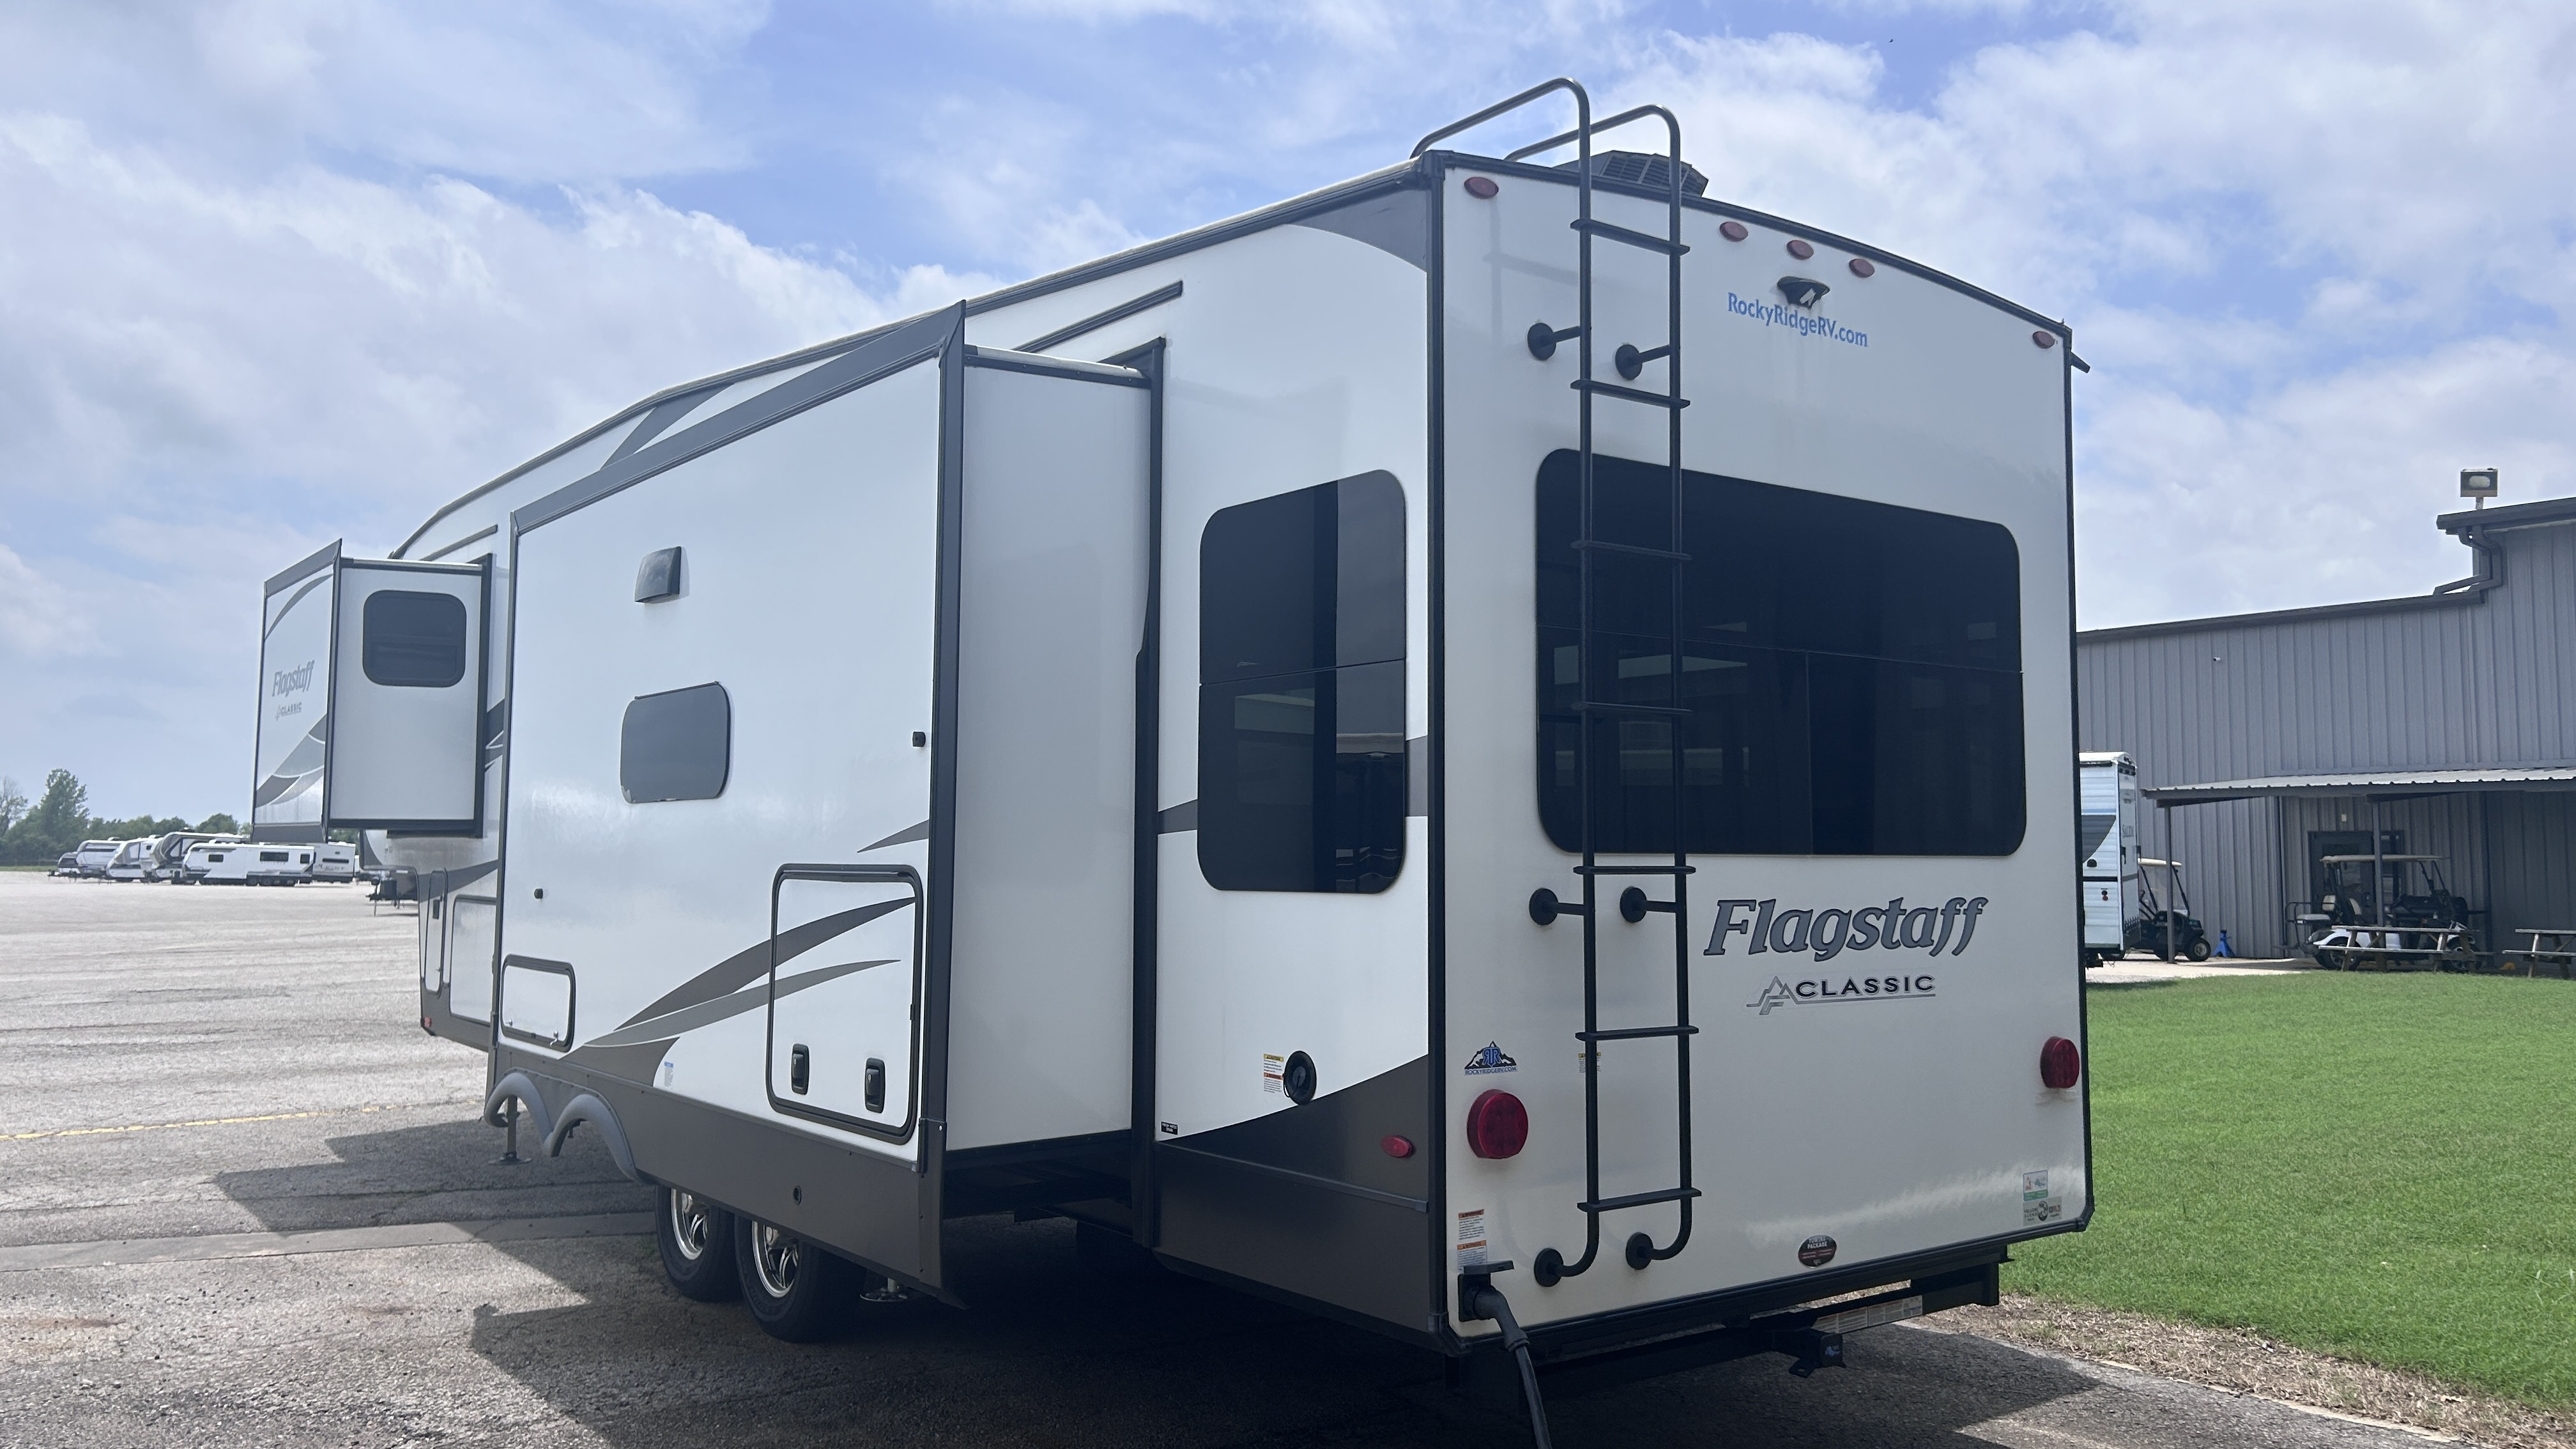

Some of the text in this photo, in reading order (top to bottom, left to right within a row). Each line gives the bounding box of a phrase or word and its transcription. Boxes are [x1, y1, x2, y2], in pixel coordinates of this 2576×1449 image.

[1727, 291, 1869, 348] RockyRidgeRV.com
[272, 659, 315, 698] Flagstaff
[1703, 896, 1989, 962] Flagstaff
[1795, 974, 1936, 998] CLASSIC
